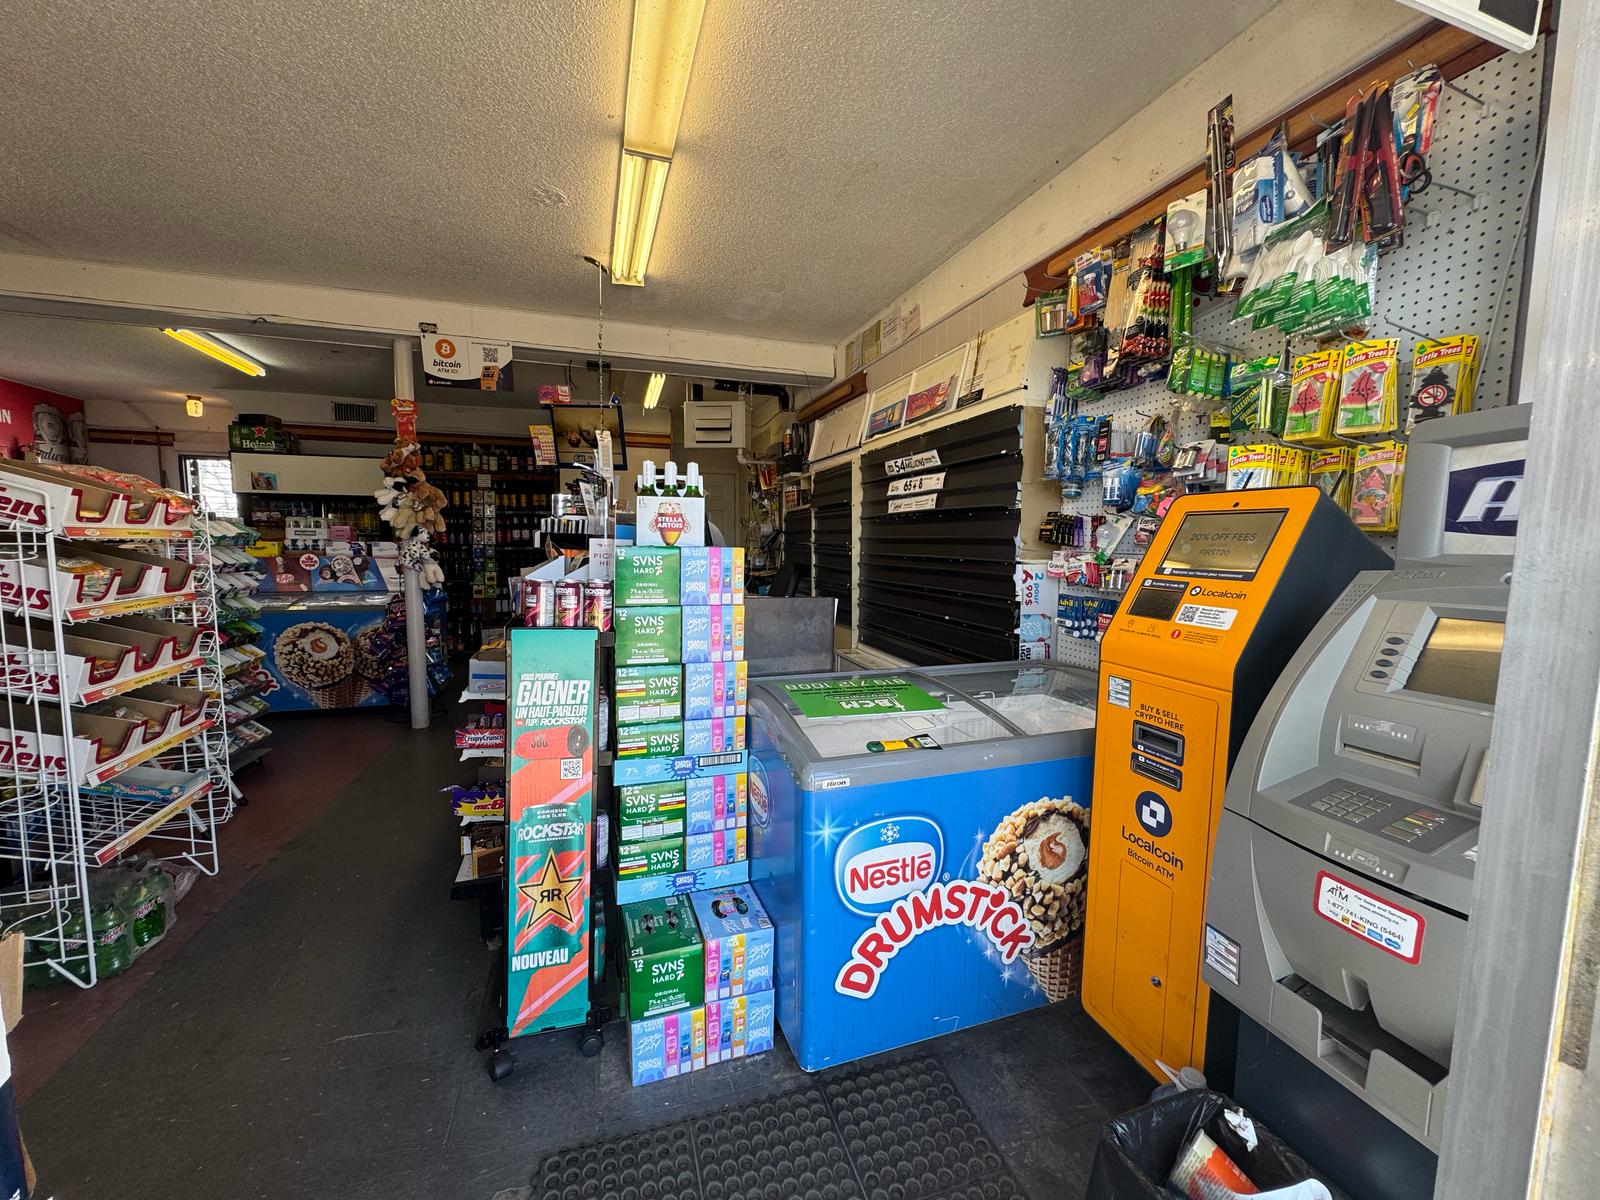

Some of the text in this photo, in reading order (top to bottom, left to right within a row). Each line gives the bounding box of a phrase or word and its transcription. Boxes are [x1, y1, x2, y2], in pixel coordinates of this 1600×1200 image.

[1346, 350, 1387, 367] Little Trees
[1416, 346, 1461, 365] Little Trees
[433, 359, 461, 369] bitcoin
[1295, 360, 1329, 379] Little Trees
[1230, 457, 1248, 465] Little
[1358, 451, 1394, 466] Little Trees
[894, 460, 906, 473] 54
[1190, 533, 1257, 541] 20% OFF FEES
[633, 556, 663, 567] SVNS
[1025, 585, 1033, 606] 99$
[1202, 588, 1247, 600] Localcoin
[634, 616, 664, 627] SVNS
[635, 627, 655, 635] HARD
[535, 672, 559, 680] POURRIEZ
[618, 669, 627, 678] 12
[649, 677, 678, 688] SVNS
[517, 680, 591, 706] GAGNER
[840, 699, 895, 709] BCM
[515, 705, 588, 719] UN HAUT-PARLEUR
[1140, 704, 1154, 714] BUY
[1162, 709, 1180, 722] SELL
[540, 717, 587, 726] ROCKSTAR
[1135, 710, 1184, 732] CRYPTO HERE
[620, 728, 629, 736] 12
[650, 734, 680, 746] SVNS
[674, 760, 693, 770] SMASH
[826, 780, 847, 788] Hiron
[622, 787, 633, 795] 12
[626, 794, 656, 806] SVNS
[517, 822, 584, 842] ROCKSTAR
[620, 847, 629, 855] 12
[1122, 826, 1184, 871] Localcoin
[650, 850, 680, 863] SVNS
[651, 863, 671, 871] HARD
[1128, 848, 1174, 881] Bitcoin ATM
[850, 852, 932, 893] Nestlé
[1327, 886, 1349, 902] ATM
[1328, 900, 1404, 943] 1-877-741-KING (5464)
[512, 947, 569, 972] NOUVEAU
[634, 960, 644, 969] 12
[652, 959, 685, 976] SVNS
[748, 966, 769, 980] SMASH
[653, 974, 675, 985] HARD
[749, 1026, 771, 1039] SMASH
[638, 1059, 662, 1073] SMASH
